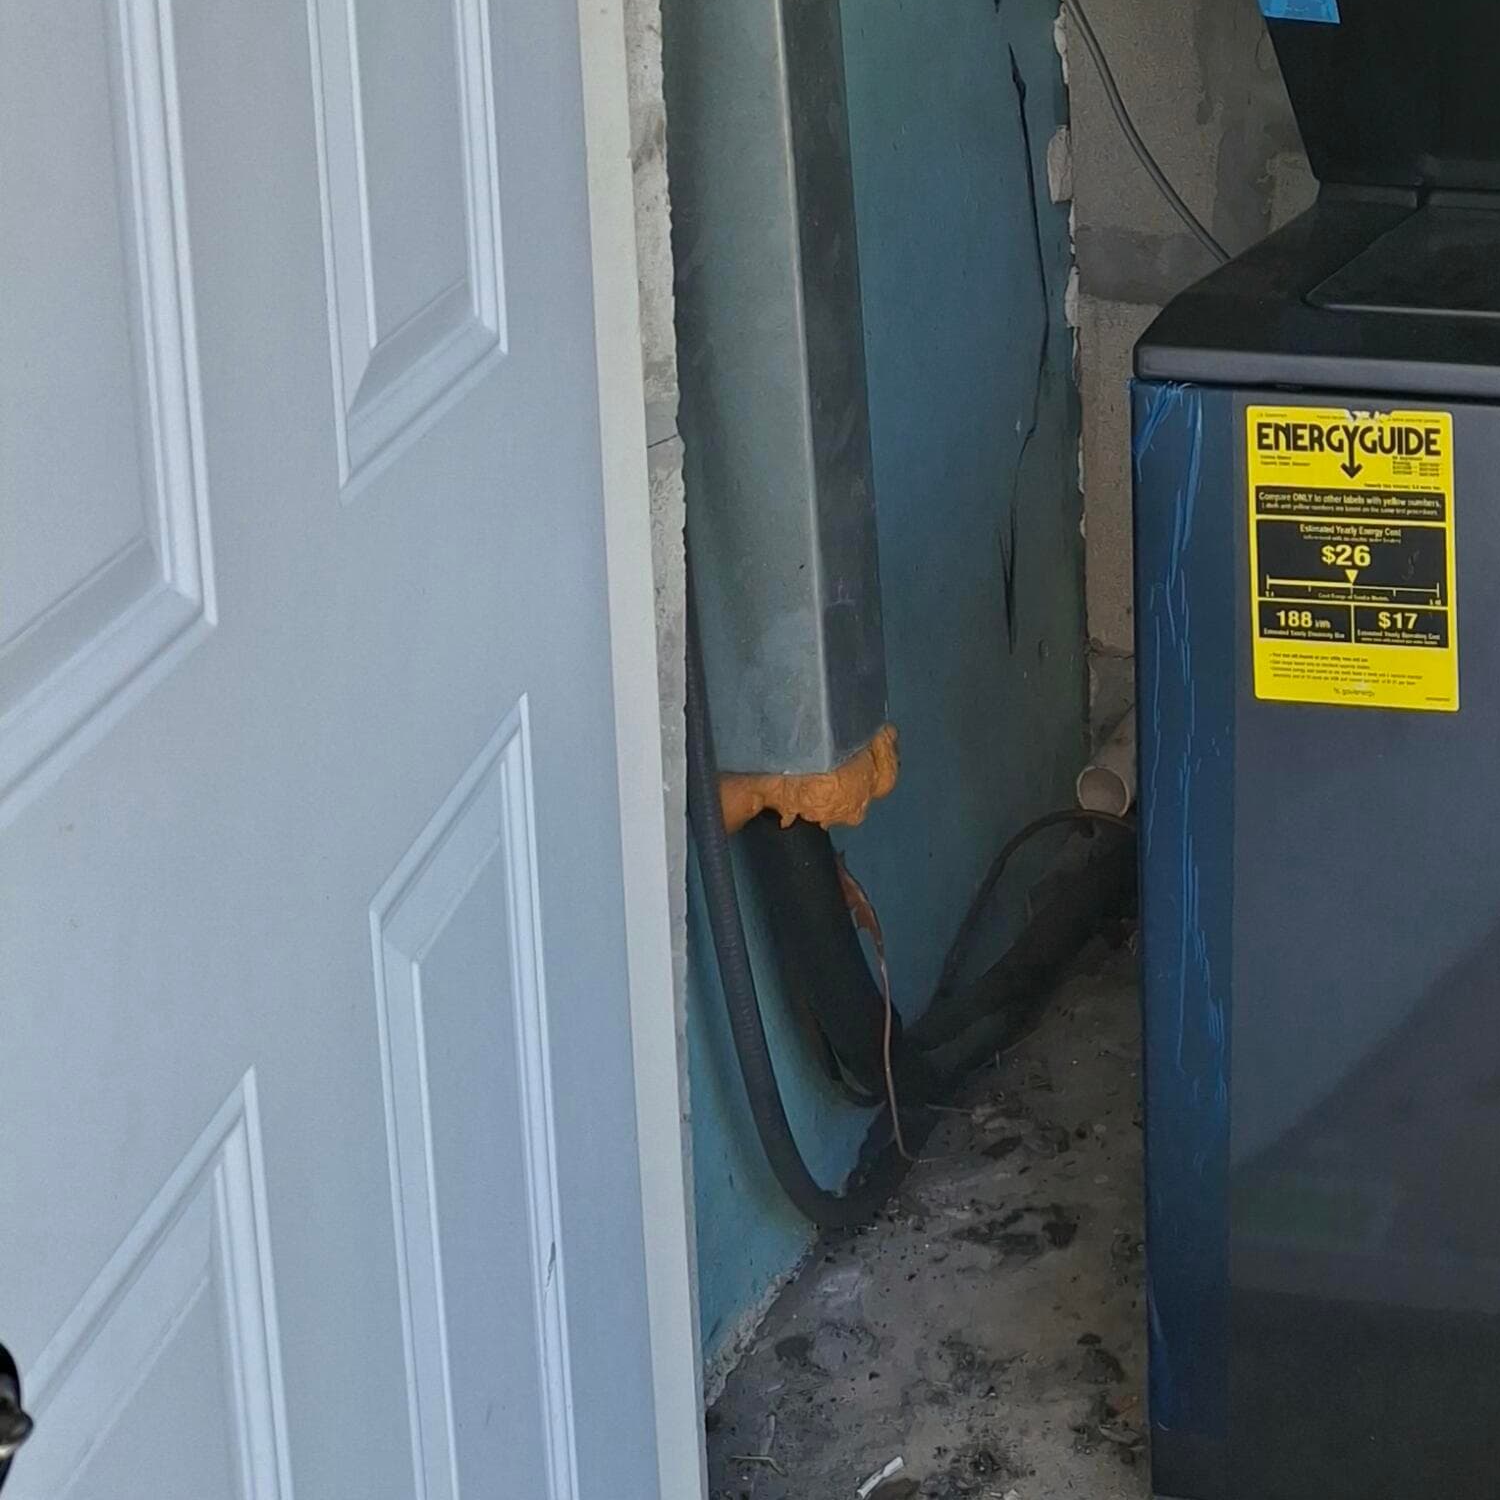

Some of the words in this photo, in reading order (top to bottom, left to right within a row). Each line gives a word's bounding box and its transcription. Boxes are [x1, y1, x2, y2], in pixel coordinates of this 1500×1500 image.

[1257, 422, 1441, 456] ENERGYGUIDE
[1259, 492, 1291, 503] Compare
[1293, 493, 1313, 502] ONLY
[1314, 493, 1321, 502] to
[1323, 494, 1341, 503] other
[1343, 495, 1364, 504] labels
[1366, 496, 1382, 505] with
[1383, 497, 1406, 507] yellow
[1300, 524, 1334, 533] Estimated
[1336, 526, 1357, 536] Yearly
[1359, 527, 1383, 538] Energy
[1385, 528, 1401, 536] Cost
[1322, 544, 1371, 566] $26
[1276, 610, 1312, 628] 188
[1315, 620, 1331, 628] kWh
[1378, 611, 1418, 629] $17
